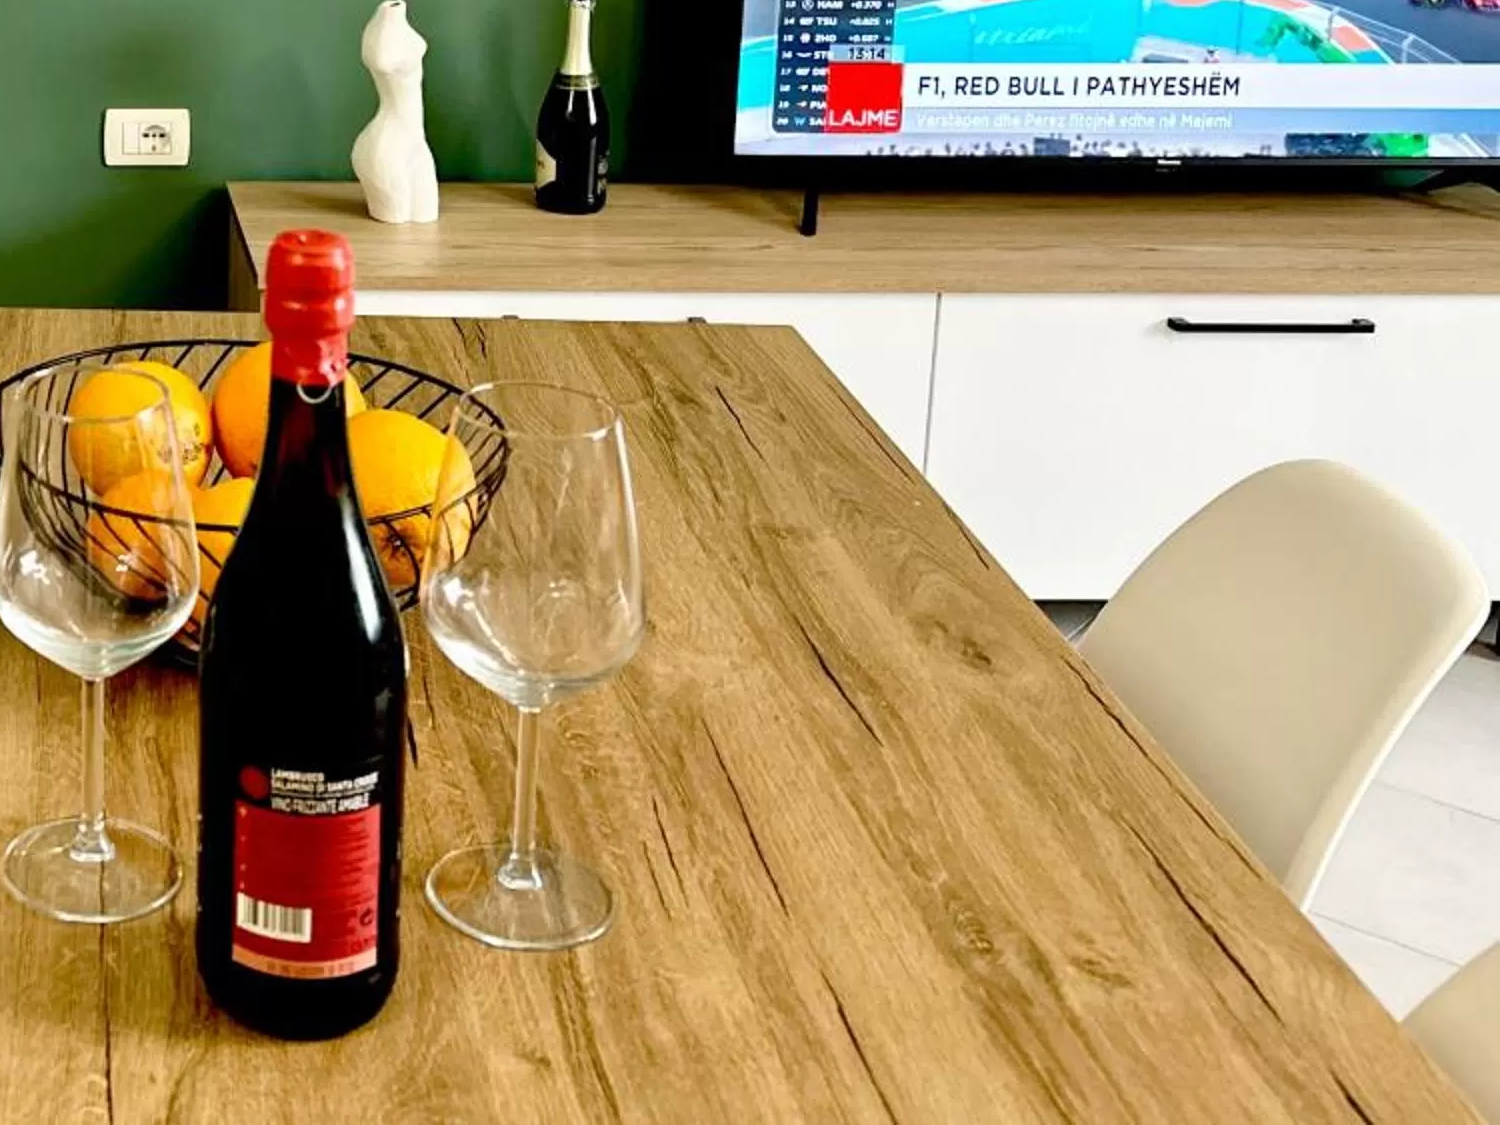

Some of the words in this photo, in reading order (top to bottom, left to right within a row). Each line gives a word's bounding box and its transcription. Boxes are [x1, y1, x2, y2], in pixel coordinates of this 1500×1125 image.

[918, 76, 946, 99] F1,
[954, 76, 1000, 96] RED
[1008, 76, 1065, 96] BULL
[1073, 76, 1079, 96] I
[1087, 71, 1241, 96] PATHYESHËM
[828, 109, 900, 127] LAJME
